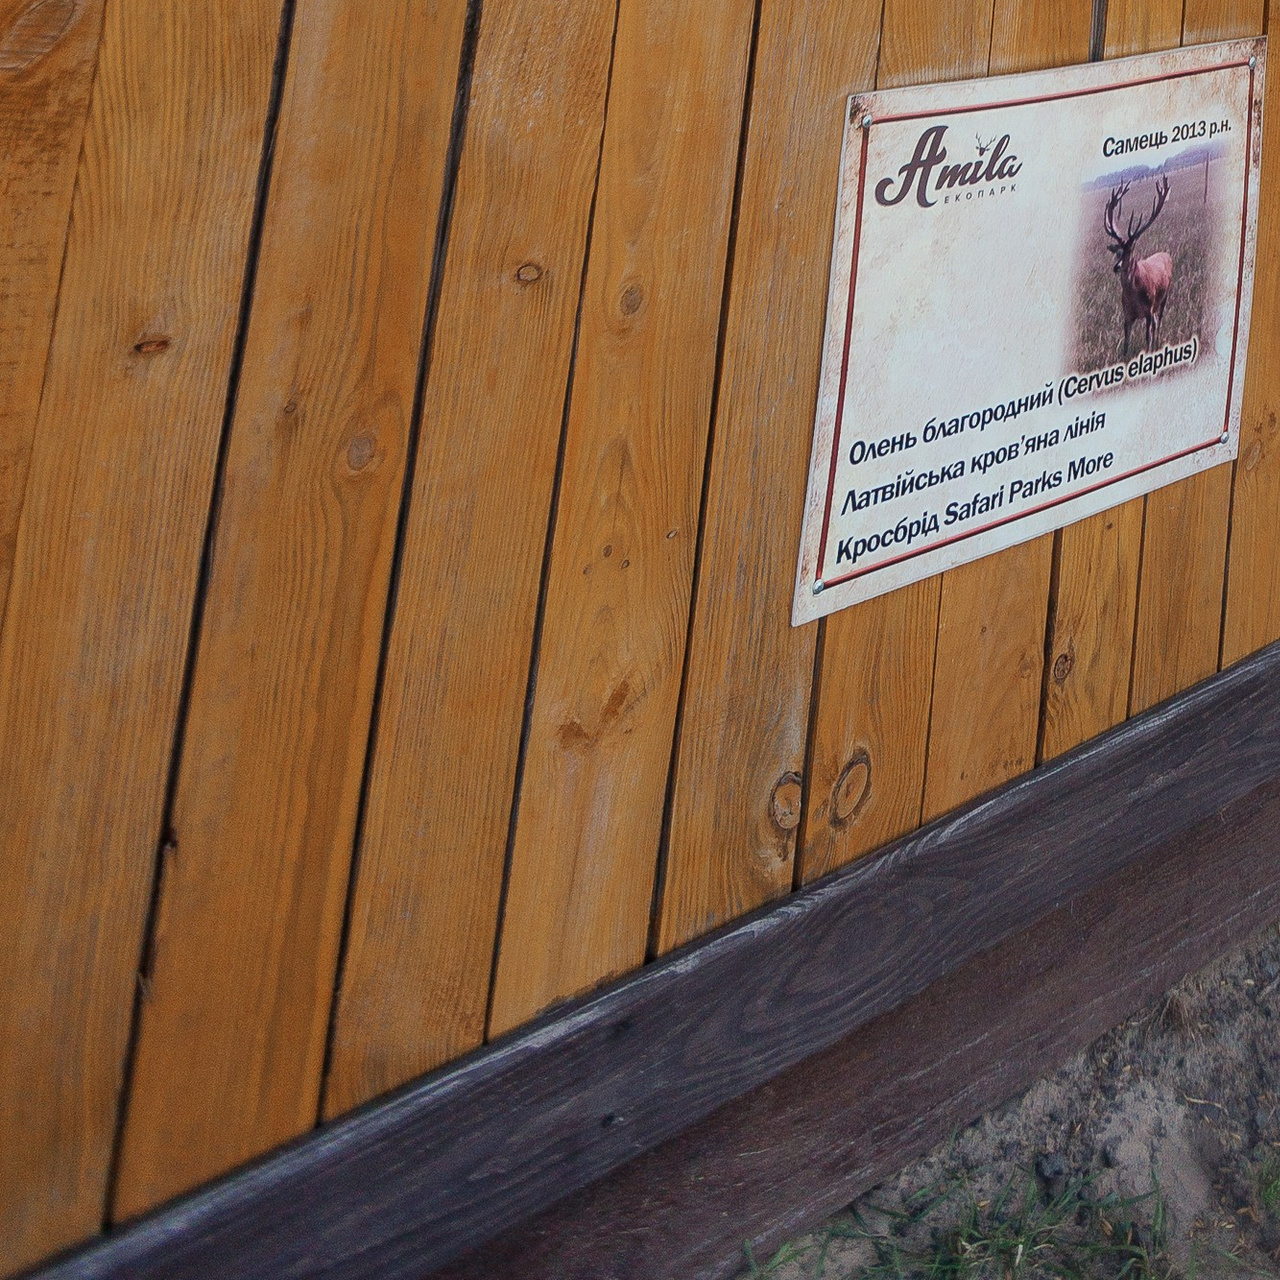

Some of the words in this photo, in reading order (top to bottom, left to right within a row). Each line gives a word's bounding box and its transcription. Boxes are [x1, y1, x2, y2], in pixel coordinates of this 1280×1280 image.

[875, 125, 1023, 208] Amila
[1103, 130, 1168, 158] Самець
[1171, 120, 1206, 143] 2013
[1209, 119, 1232, 139] р.н.
[943, 183, 1017, 204] ЕКОПАРК
[849, 431, 917, 465] Олень
[922, 381, 1054, 444] благородний
[1057, 364, 1125, 406] (Cervus
[1127, 337, 1198, 377] elaphus)
[835, 511, 940, 565] Кросбрід
[943, 485, 1004, 526] Safari
[1008, 470, 1063, 504] Parks
[1066, 451, 1114, 483] More
[840, 459, 966, 517] Латвійська
[970, 428, 1060, 475] кров’яна
[1063, 410, 1106, 442] лінія
